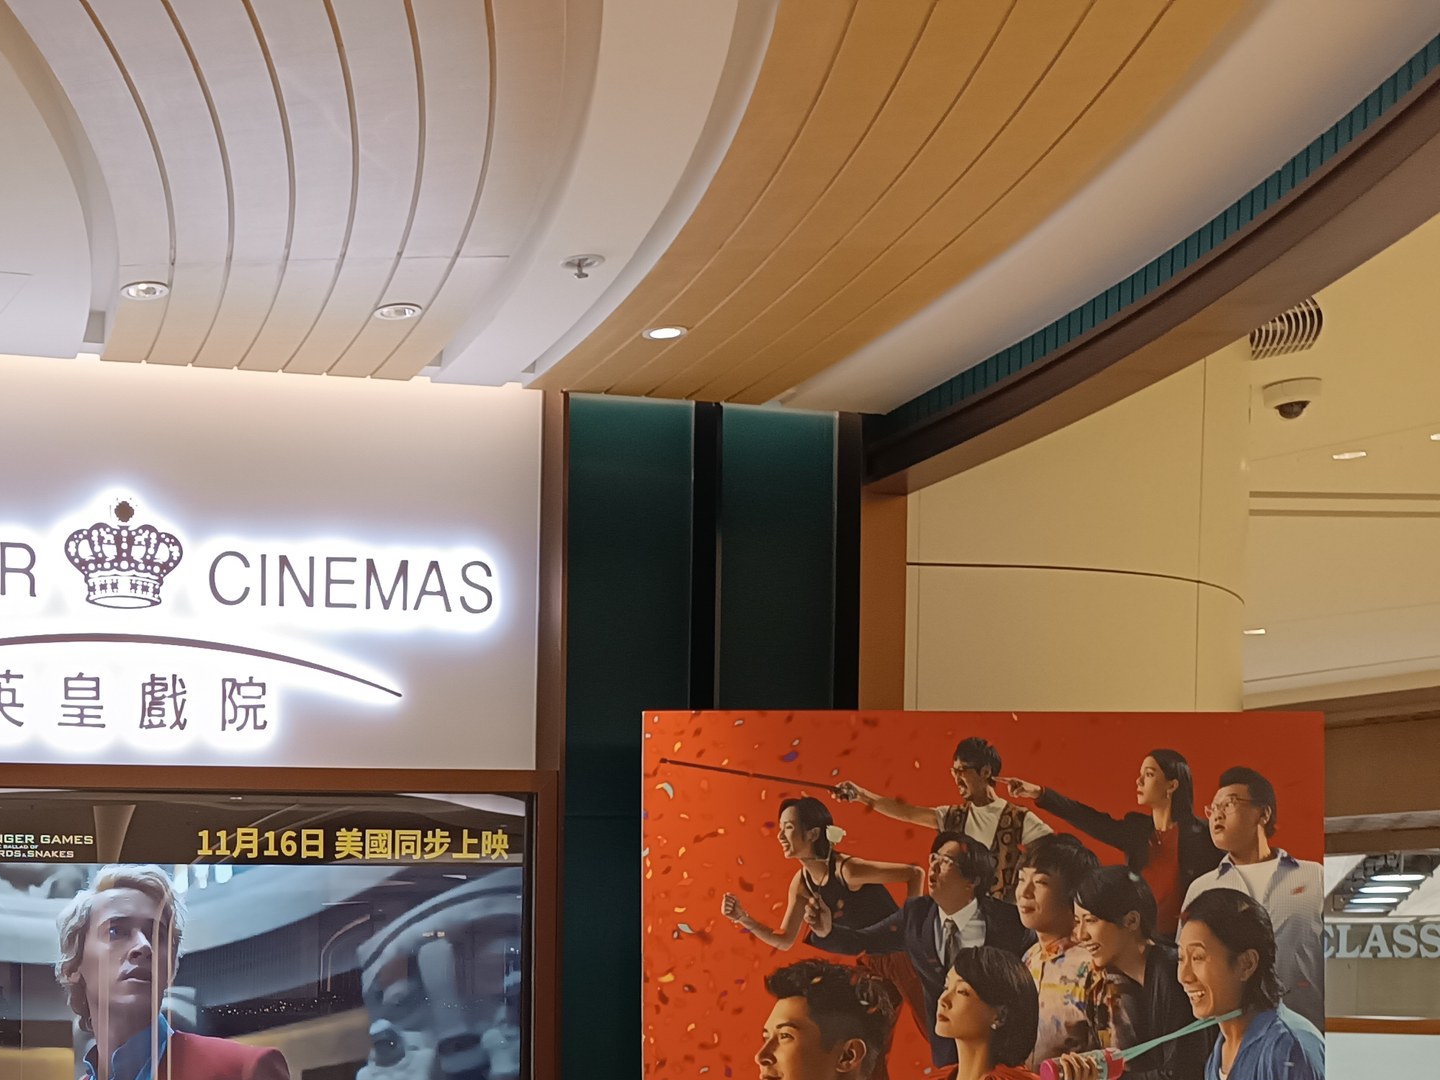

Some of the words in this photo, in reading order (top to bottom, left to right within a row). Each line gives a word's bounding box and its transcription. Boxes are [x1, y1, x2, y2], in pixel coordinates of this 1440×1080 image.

[207, 550, 495, 615] CINEMAS
[40, 835, 94, 845] GAMES
[196, 827, 326, 859] 11月16日
[334, 827, 510, 860] 美國同步上映
